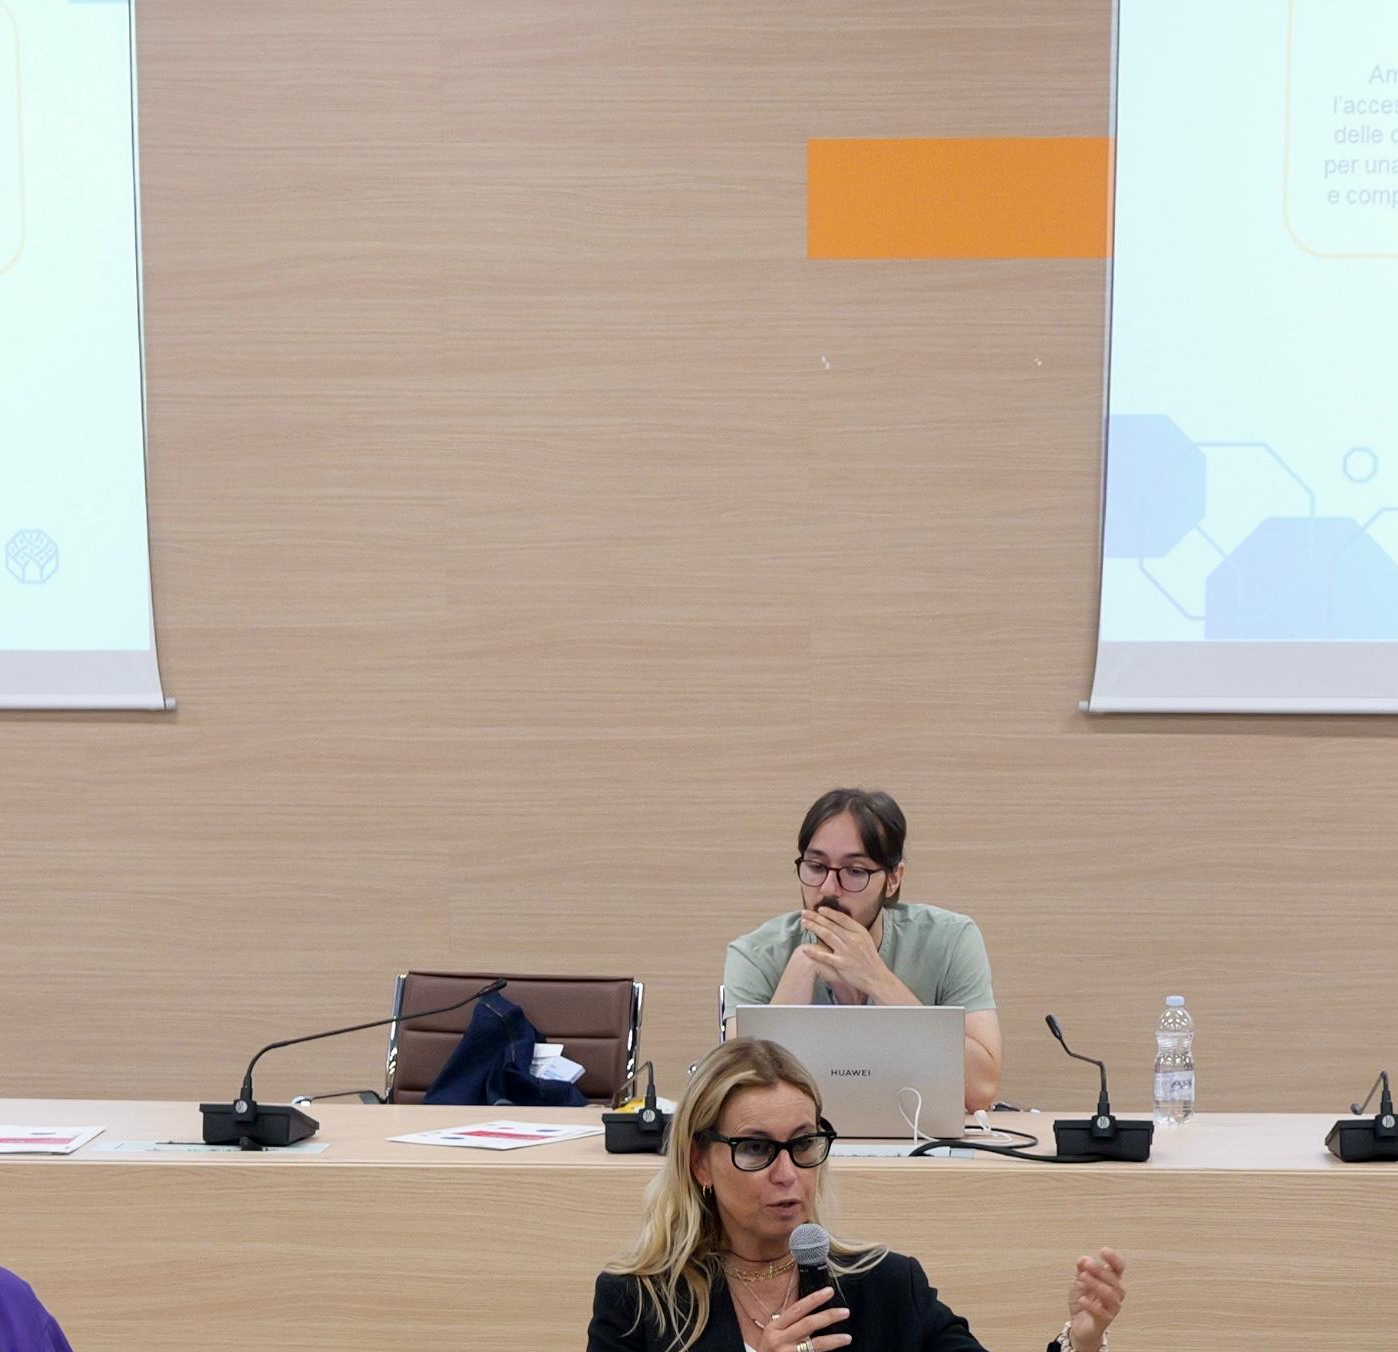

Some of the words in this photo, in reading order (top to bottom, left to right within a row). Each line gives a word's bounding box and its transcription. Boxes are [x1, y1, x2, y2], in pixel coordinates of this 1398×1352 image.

[1333, 124, 1384, 145] delle
[1323, 158, 1359, 180] per
[1326, 188, 1341, 206] e
[830, 1068, 871, 1077] HUAWEI
